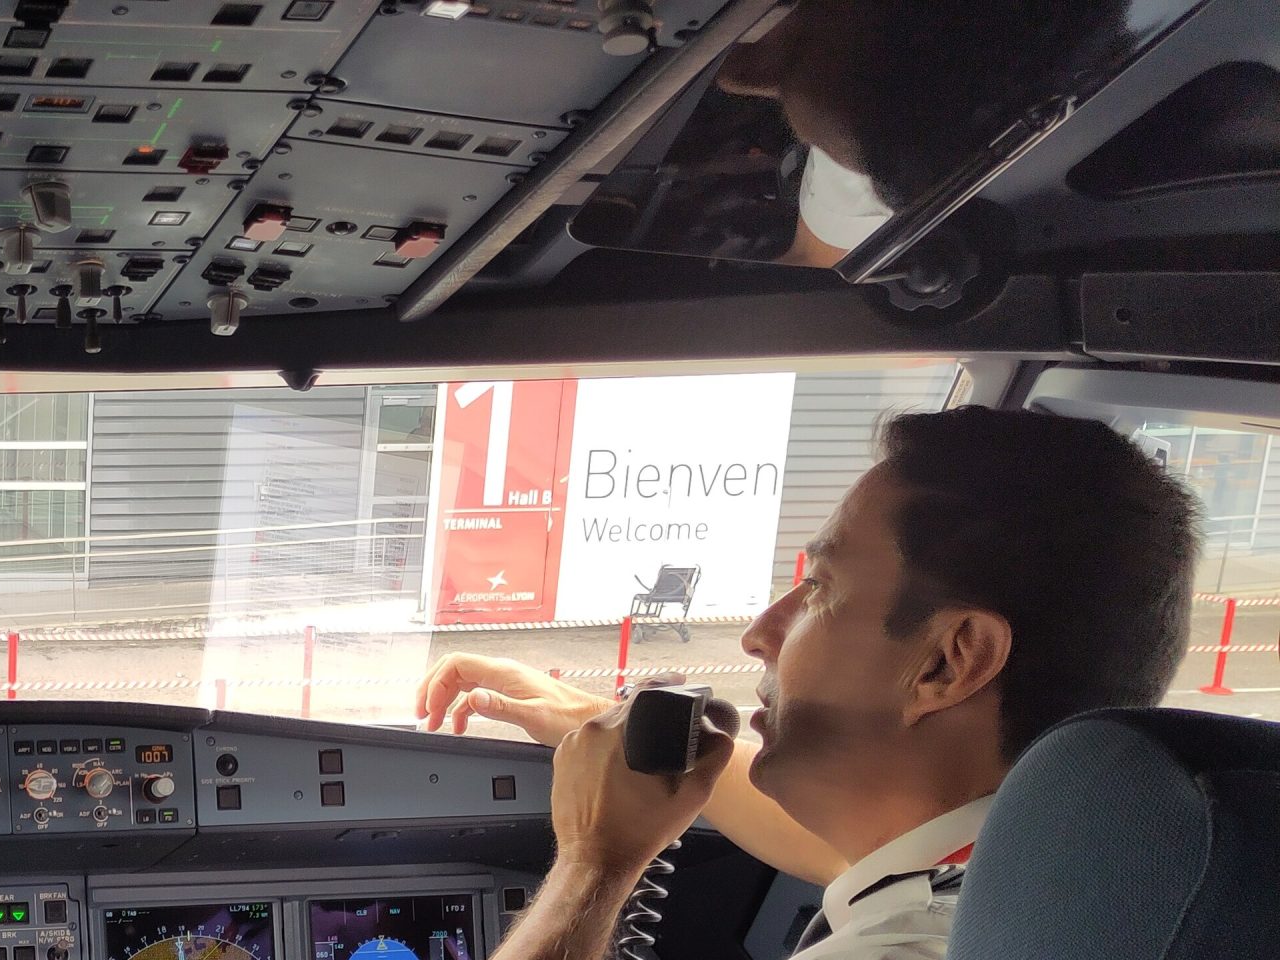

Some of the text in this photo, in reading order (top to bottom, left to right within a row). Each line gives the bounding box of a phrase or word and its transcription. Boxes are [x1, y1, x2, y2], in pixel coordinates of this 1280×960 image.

[454, 380, 514, 507] 1
[583, 449, 779, 500] Bienven
[508, 490, 552, 506] Hall B
[443, 517, 502, 530] TERMINAL
[582, 516, 708, 543] Welcome
[141, 751, 169, 762] 1007
[157, 926, 167, 934] 18
[216, 925, 225, 933] 21
